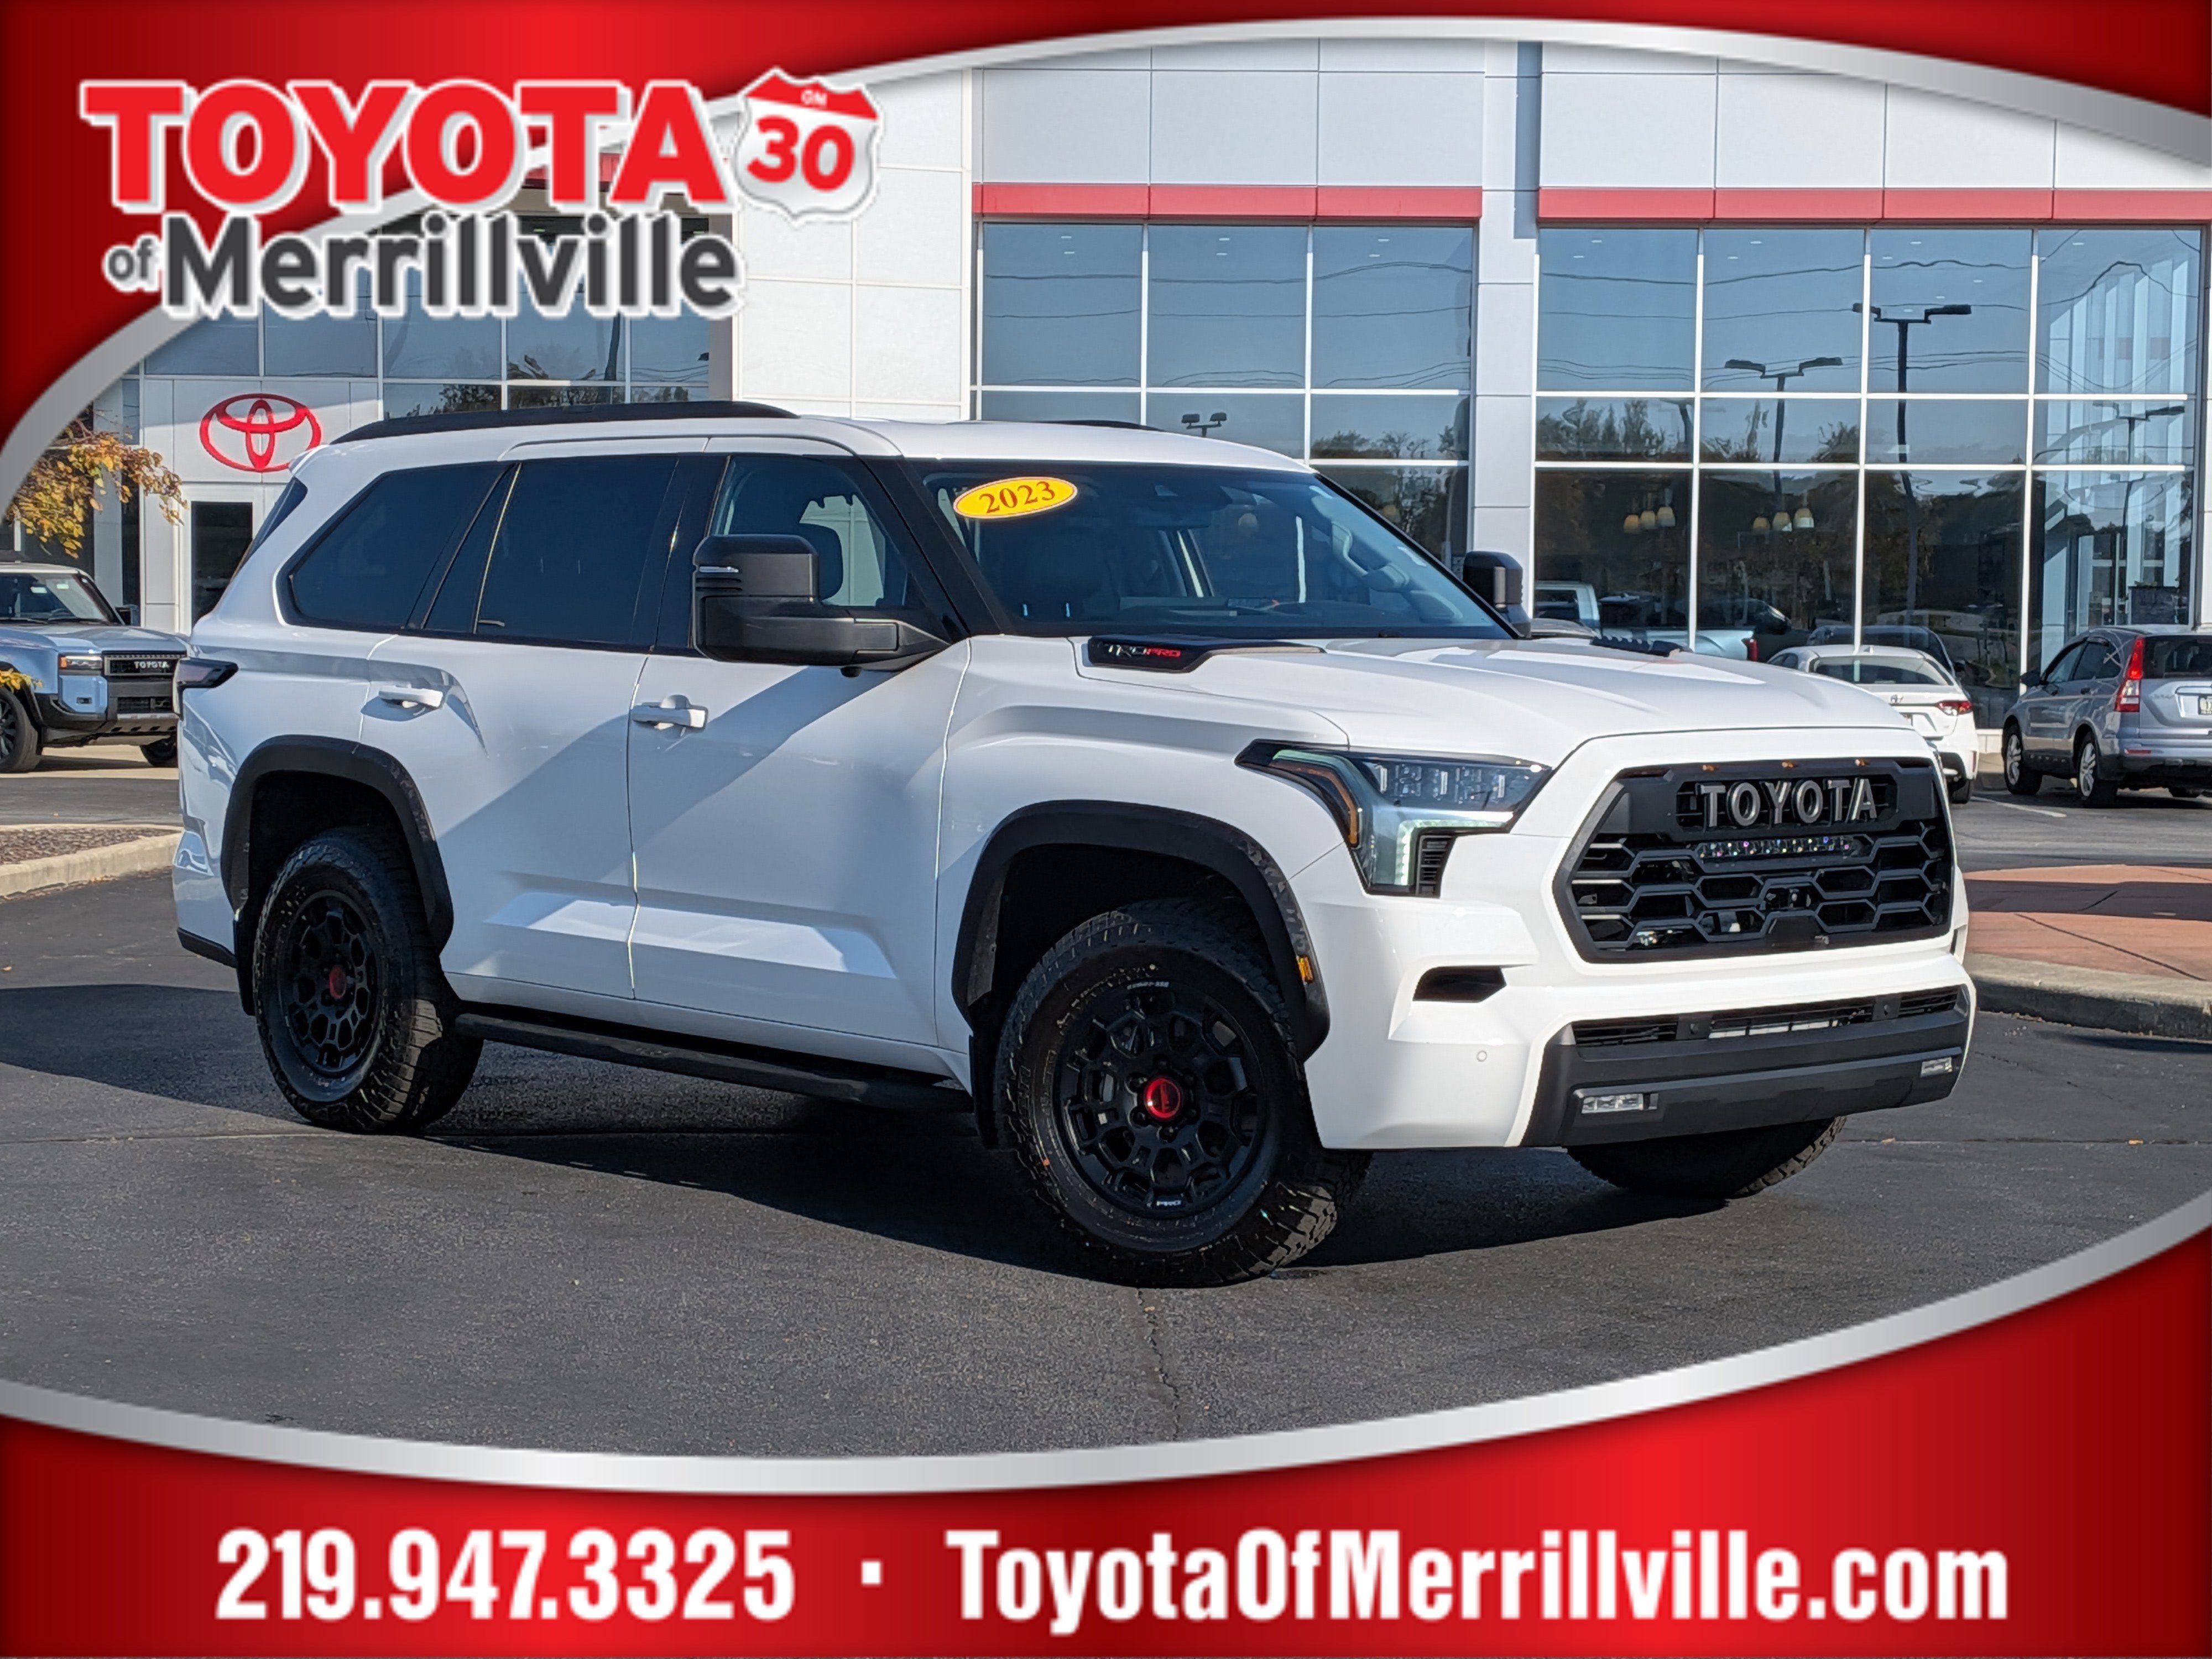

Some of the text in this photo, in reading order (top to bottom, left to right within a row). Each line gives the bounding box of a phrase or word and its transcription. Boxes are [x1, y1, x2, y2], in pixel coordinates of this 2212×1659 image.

[979, 481, 1056, 514] 2023
[134, 661, 170, 669] TOYOTA
[1695, 776, 1877, 830] TOYOTA
